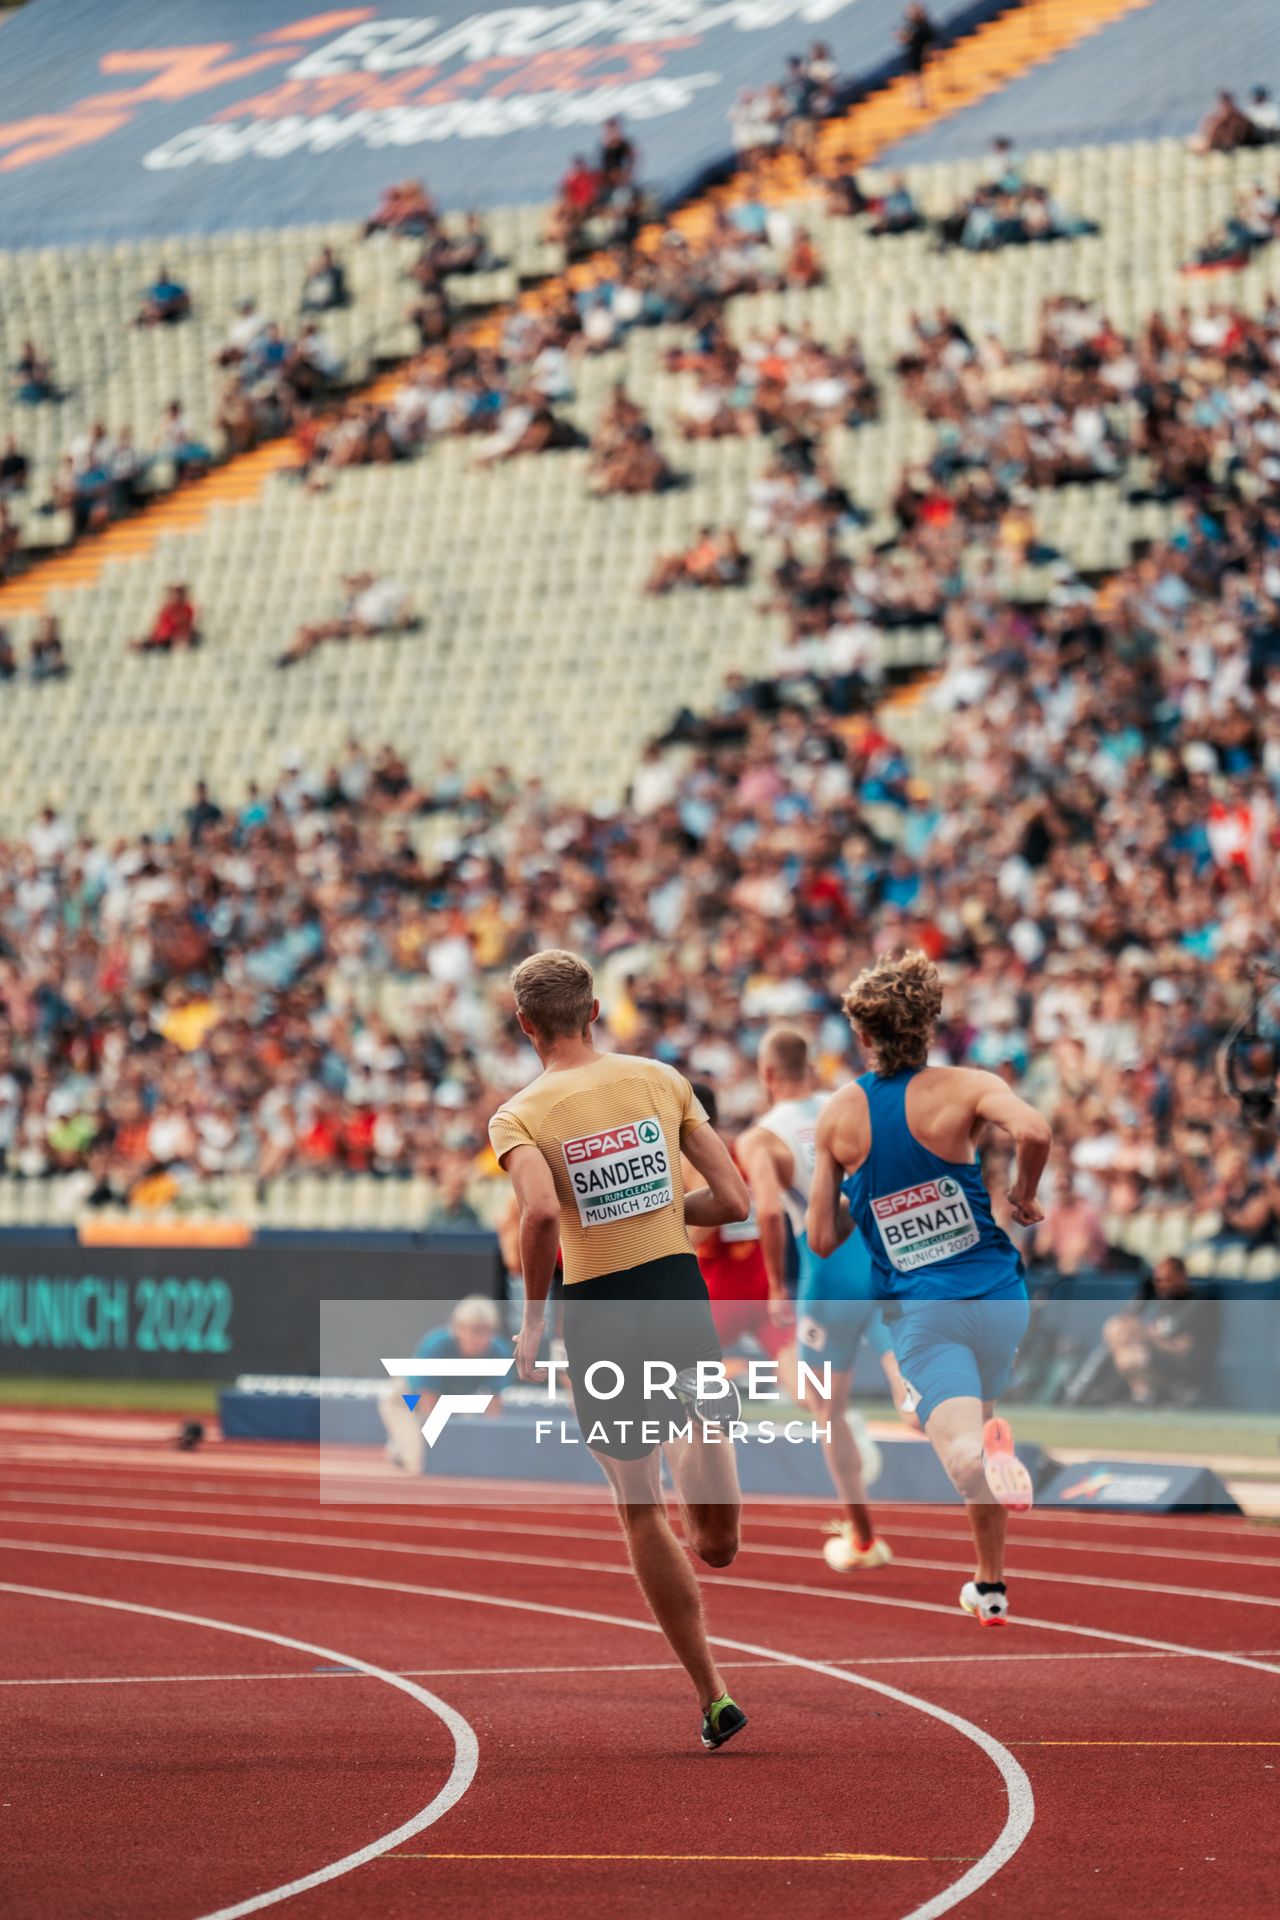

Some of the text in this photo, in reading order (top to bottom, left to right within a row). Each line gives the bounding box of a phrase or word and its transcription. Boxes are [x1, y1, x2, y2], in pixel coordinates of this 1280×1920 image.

[566, 1128, 637, 1162] SPAR
[574, 1150, 667, 1194] SANDERS
[586, 1189, 671, 1223] MUNICH 2022
[604, 1189, 624, 1203] RUN
[876, 1184, 938, 1217] SPAR
[884, 1201, 969, 1246] BENATI
[897, 1233, 976, 1269] MUNICH 2022
[136, 1276, 233, 1353] 2022
